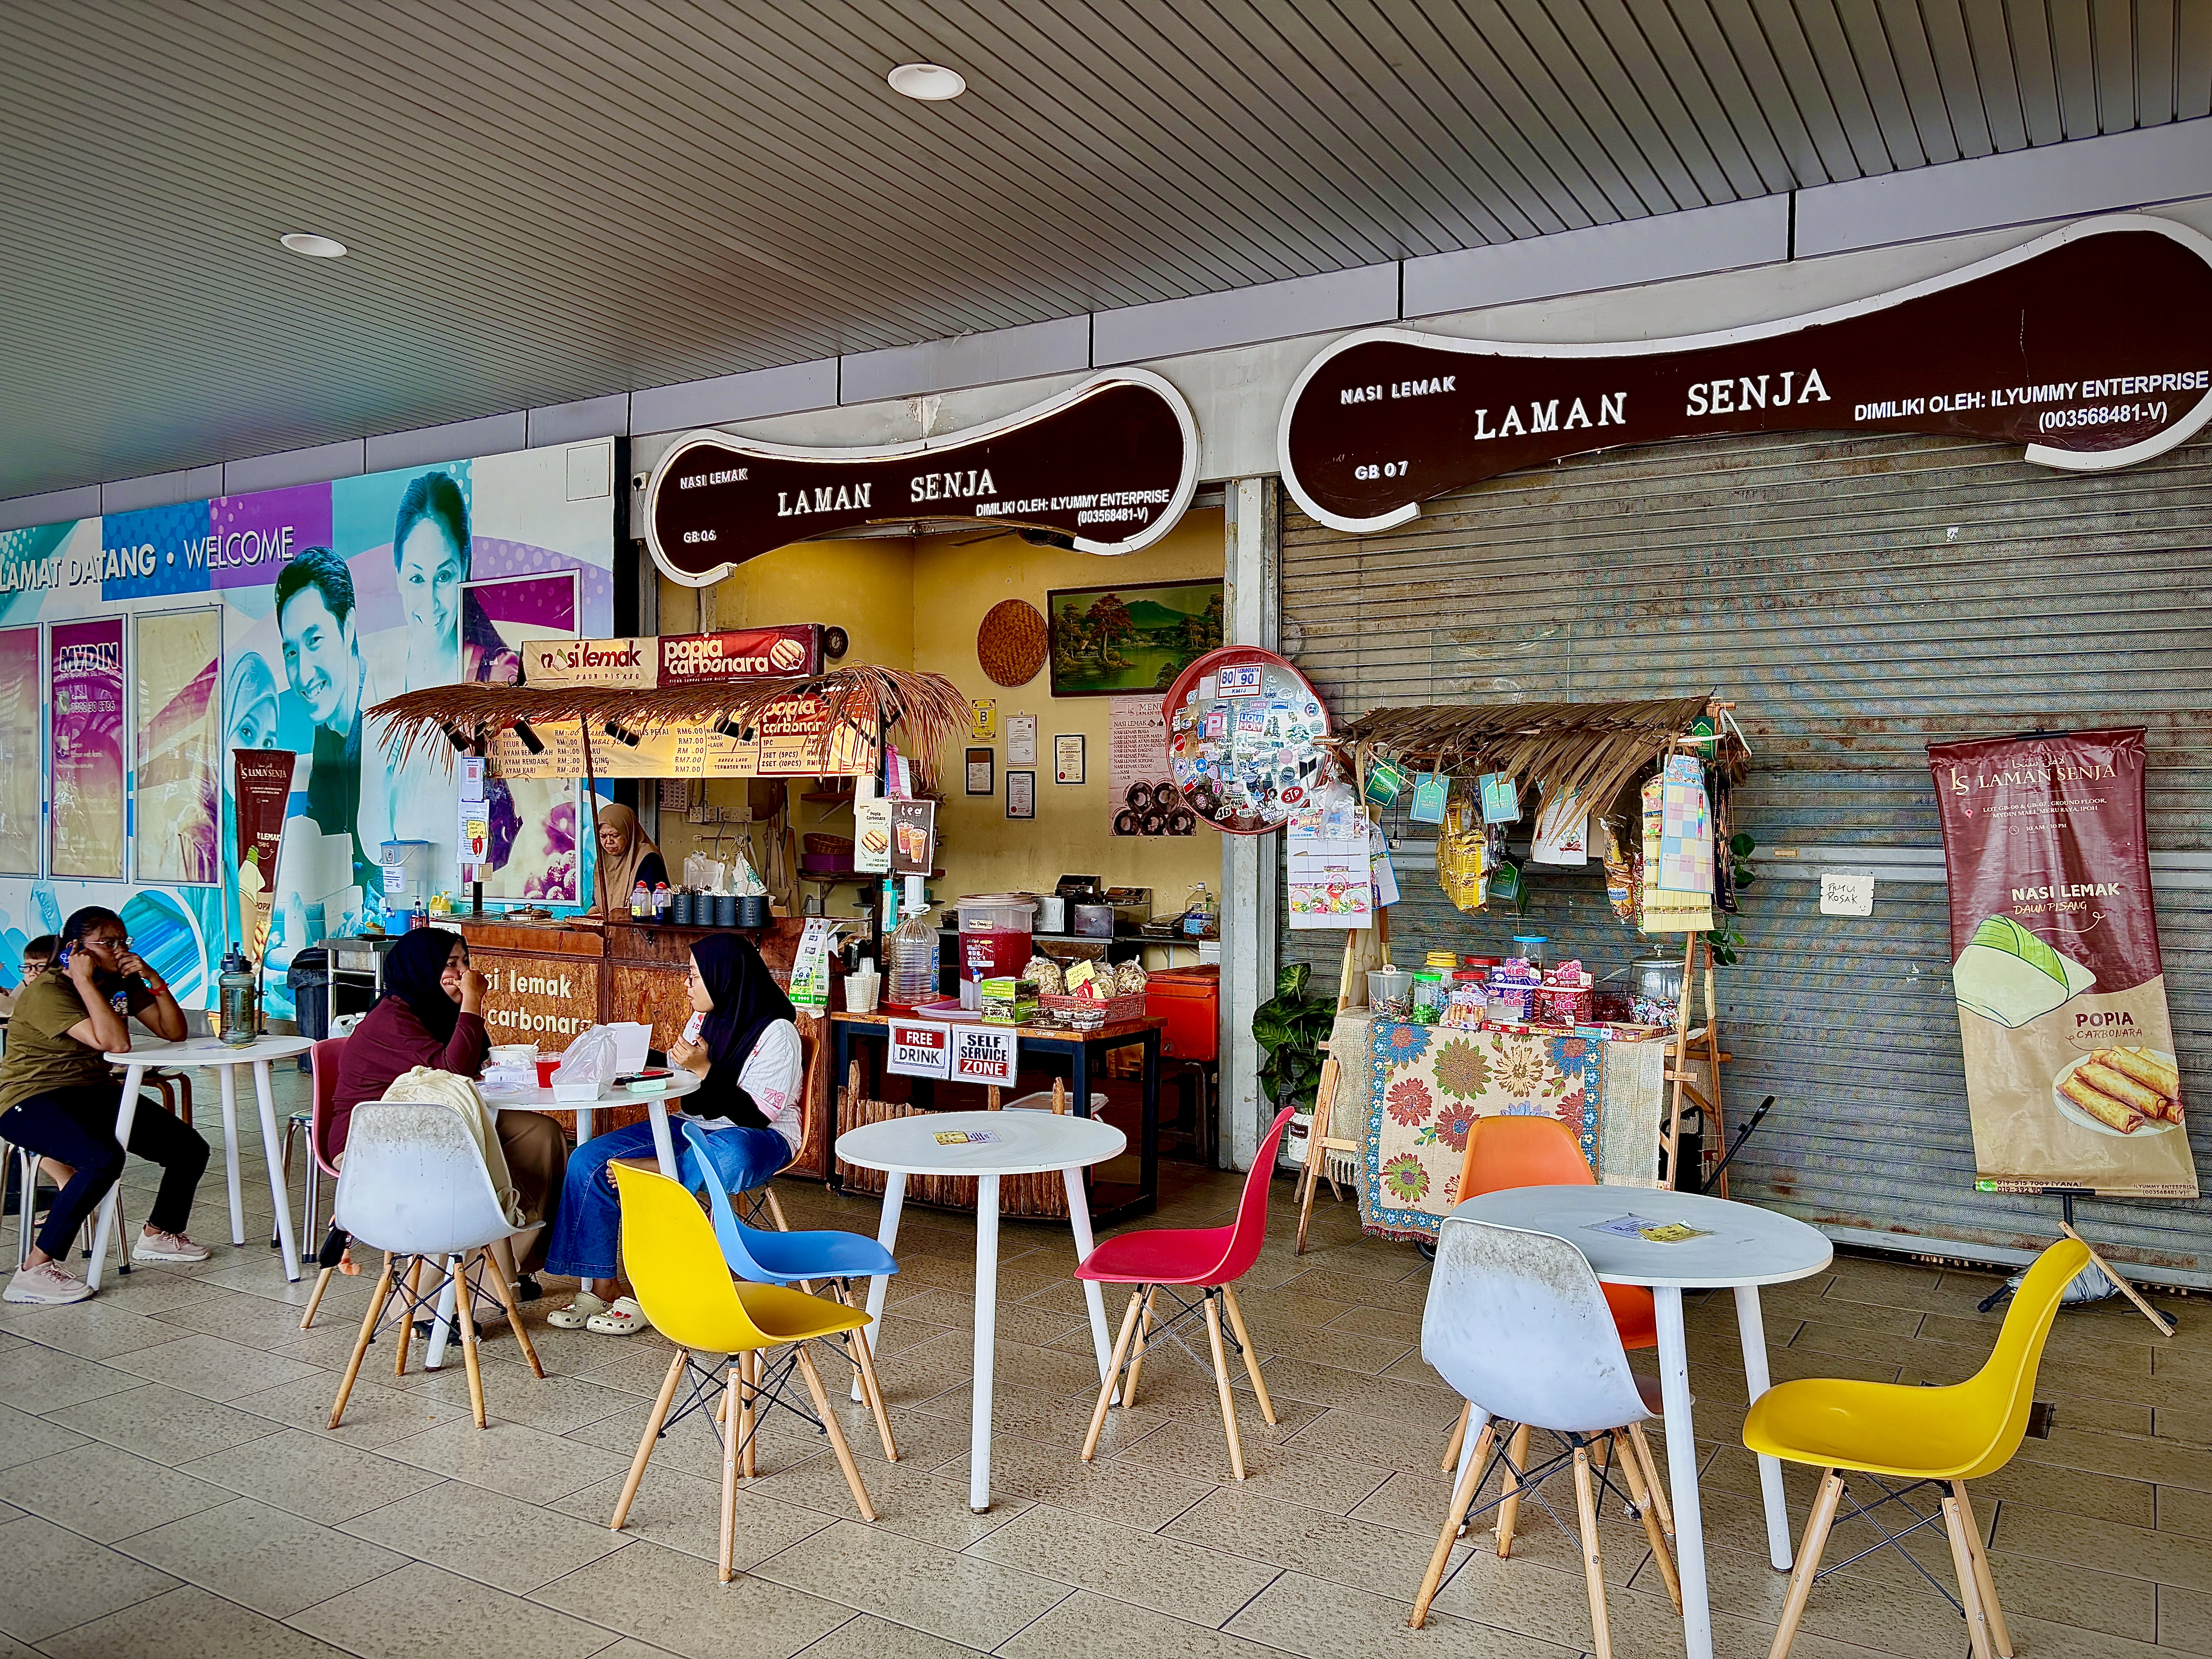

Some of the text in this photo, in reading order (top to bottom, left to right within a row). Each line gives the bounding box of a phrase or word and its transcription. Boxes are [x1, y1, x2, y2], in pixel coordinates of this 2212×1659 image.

[1341, 375, 1456, 405] NASI LEMAK
[1855, 370, 2209, 421] DIMILIKI OLEH: ILYUMMY ENTERPRISE
[1474, 368, 1831, 441] LAMAN SENJA
[2039, 401, 2167, 433] (003568481-V)
[680, 468, 748, 489] NASI LEMAK
[1355, 460, 1409, 481] GB 07
[778, 468, 996, 516] LAMAN SENJA
[976, 488, 1170, 517] DIMILIKI OLEH: ILYUMMY ENTERPRISE
[1077, 507, 1149, 525] (003568481-V)
[684, 529, 716, 543] GB 06
[69, 543, 155, 586] DATANG
[184, 526, 295, 569] WELCOME
[59, 642, 118, 672] MYDIN
[541, 640, 642, 670] nsi lemak
[665, 633, 723, 666] popia
[669, 655, 768, 675] carbonara
[1222, 671, 1234, 684] 80
[1241, 673, 1254, 685] 90
[763, 697, 816, 722] popia
[980, 711, 988, 722] B
[1208, 716, 1221, 733] P
[1240, 714, 1263, 723] LIQUI
[1240, 722, 1262, 732] MOLY
[522, 758, 549, 766] RENDANG
[1182, 773, 1196, 786] PEPSI
[1978, 769, 2051, 789] LAMAN
[2057, 764, 2117, 782] SENJA
[1284, 789, 1300, 802] STP
[902, 805, 922, 817] tea
[1216, 806, 1230, 819] 46
[1998, 804, 2018, 812] GB-06
[1825, 891, 1858, 904] ROSAK
[2012, 882, 2121, 902] NASI LEMAK
[2013, 901, 2087, 915] DAUN PISANG
[1504, 967, 1529, 977] KUBE
[510, 969, 573, 998] lemak
[1503, 998, 1525, 1006] KUBE
[1554, 1001, 1577, 1010] KUBE
[2075, 1012, 2134, 1028] POPIA
[905, 1031, 933, 1046] FREE
[966, 1034, 1002, 1049] SELF
[2076, 1028, 2143, 1039] CARBONARA
[898, 1047, 940, 1065] DRINK
[960, 1046, 1008, 1062] SERVICE
[961, 1061, 1005, 1077] ZONE
[764, 1087, 785, 1110] 79
